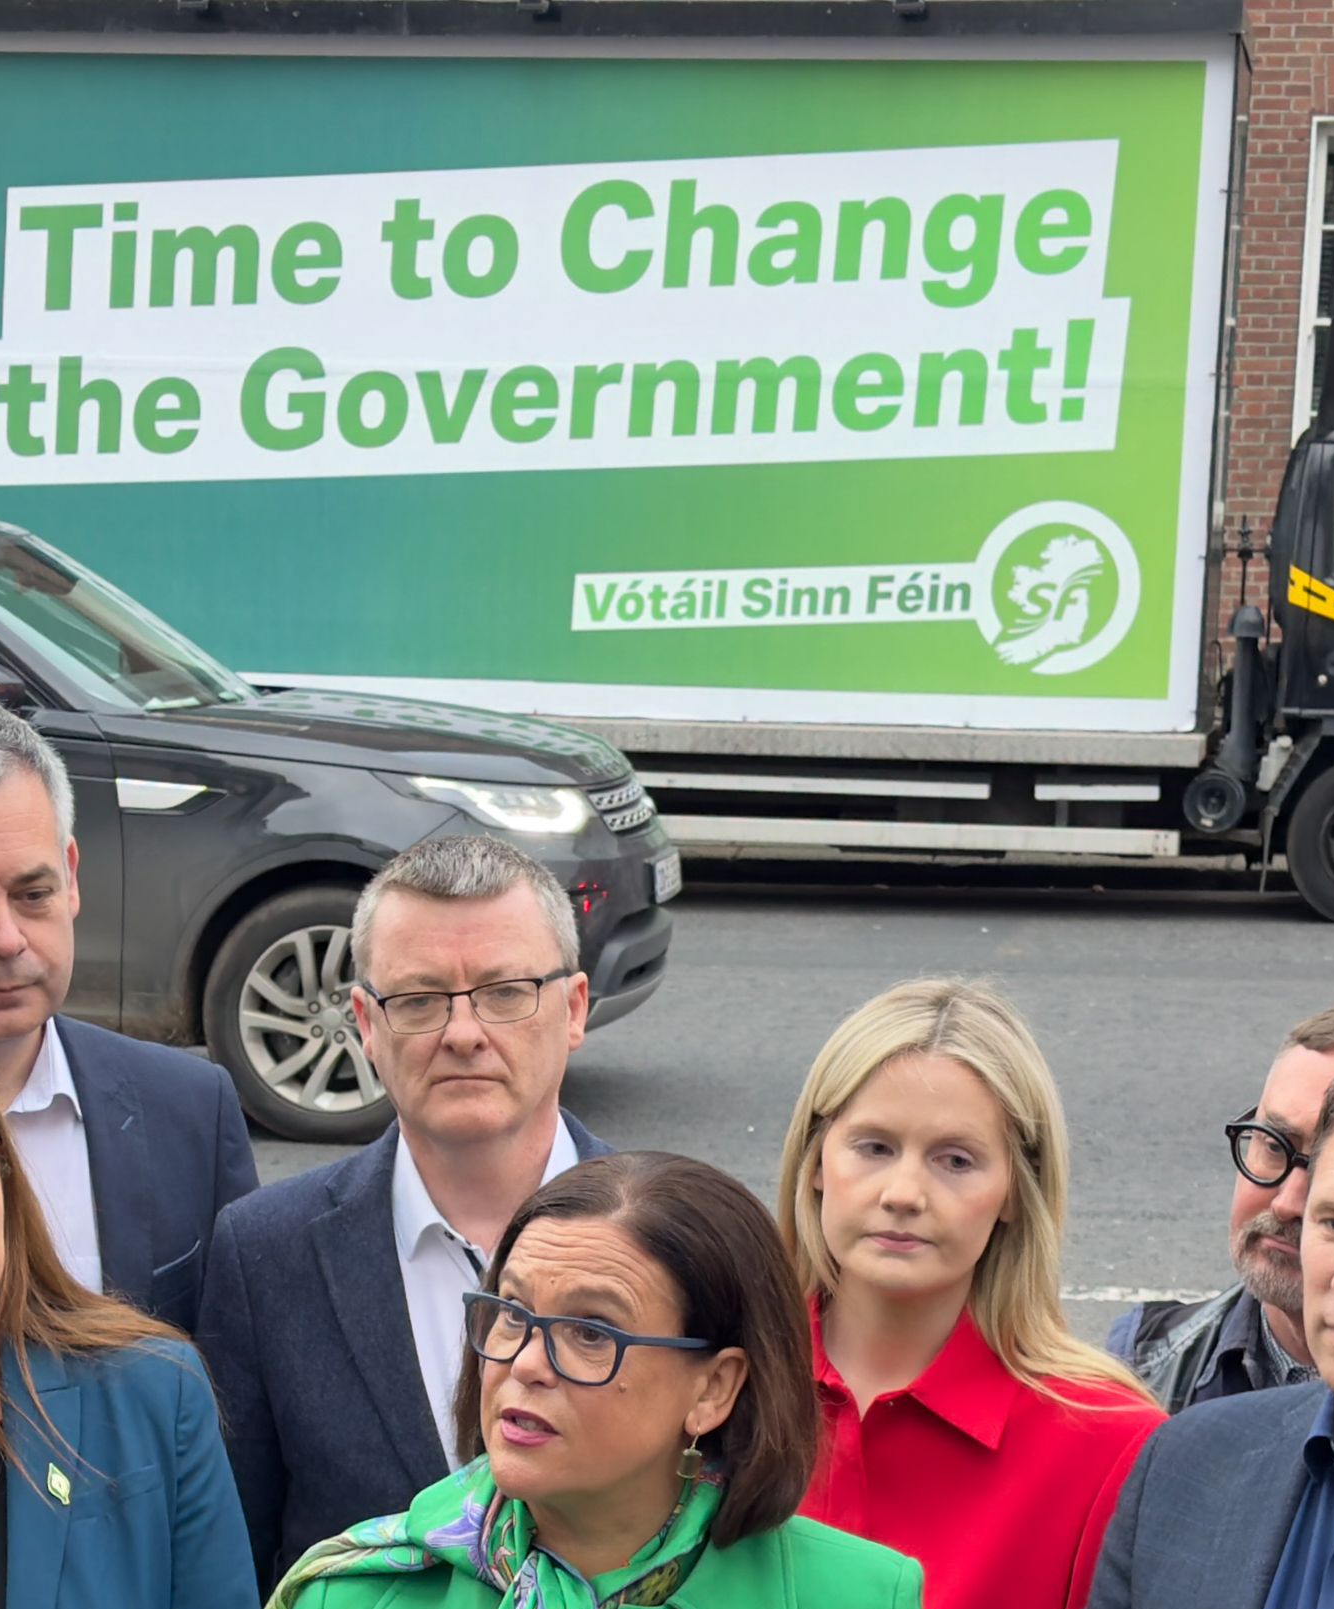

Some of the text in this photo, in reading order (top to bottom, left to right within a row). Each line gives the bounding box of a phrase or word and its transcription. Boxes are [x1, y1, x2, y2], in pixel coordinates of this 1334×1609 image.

[19, 178, 1093, 311] Time to Change
[239, 318, 1095, 452] Government!
[583, 572, 972, 623] Vótáil Sinn Féin
[1024, 582, 1086, 621] SF
